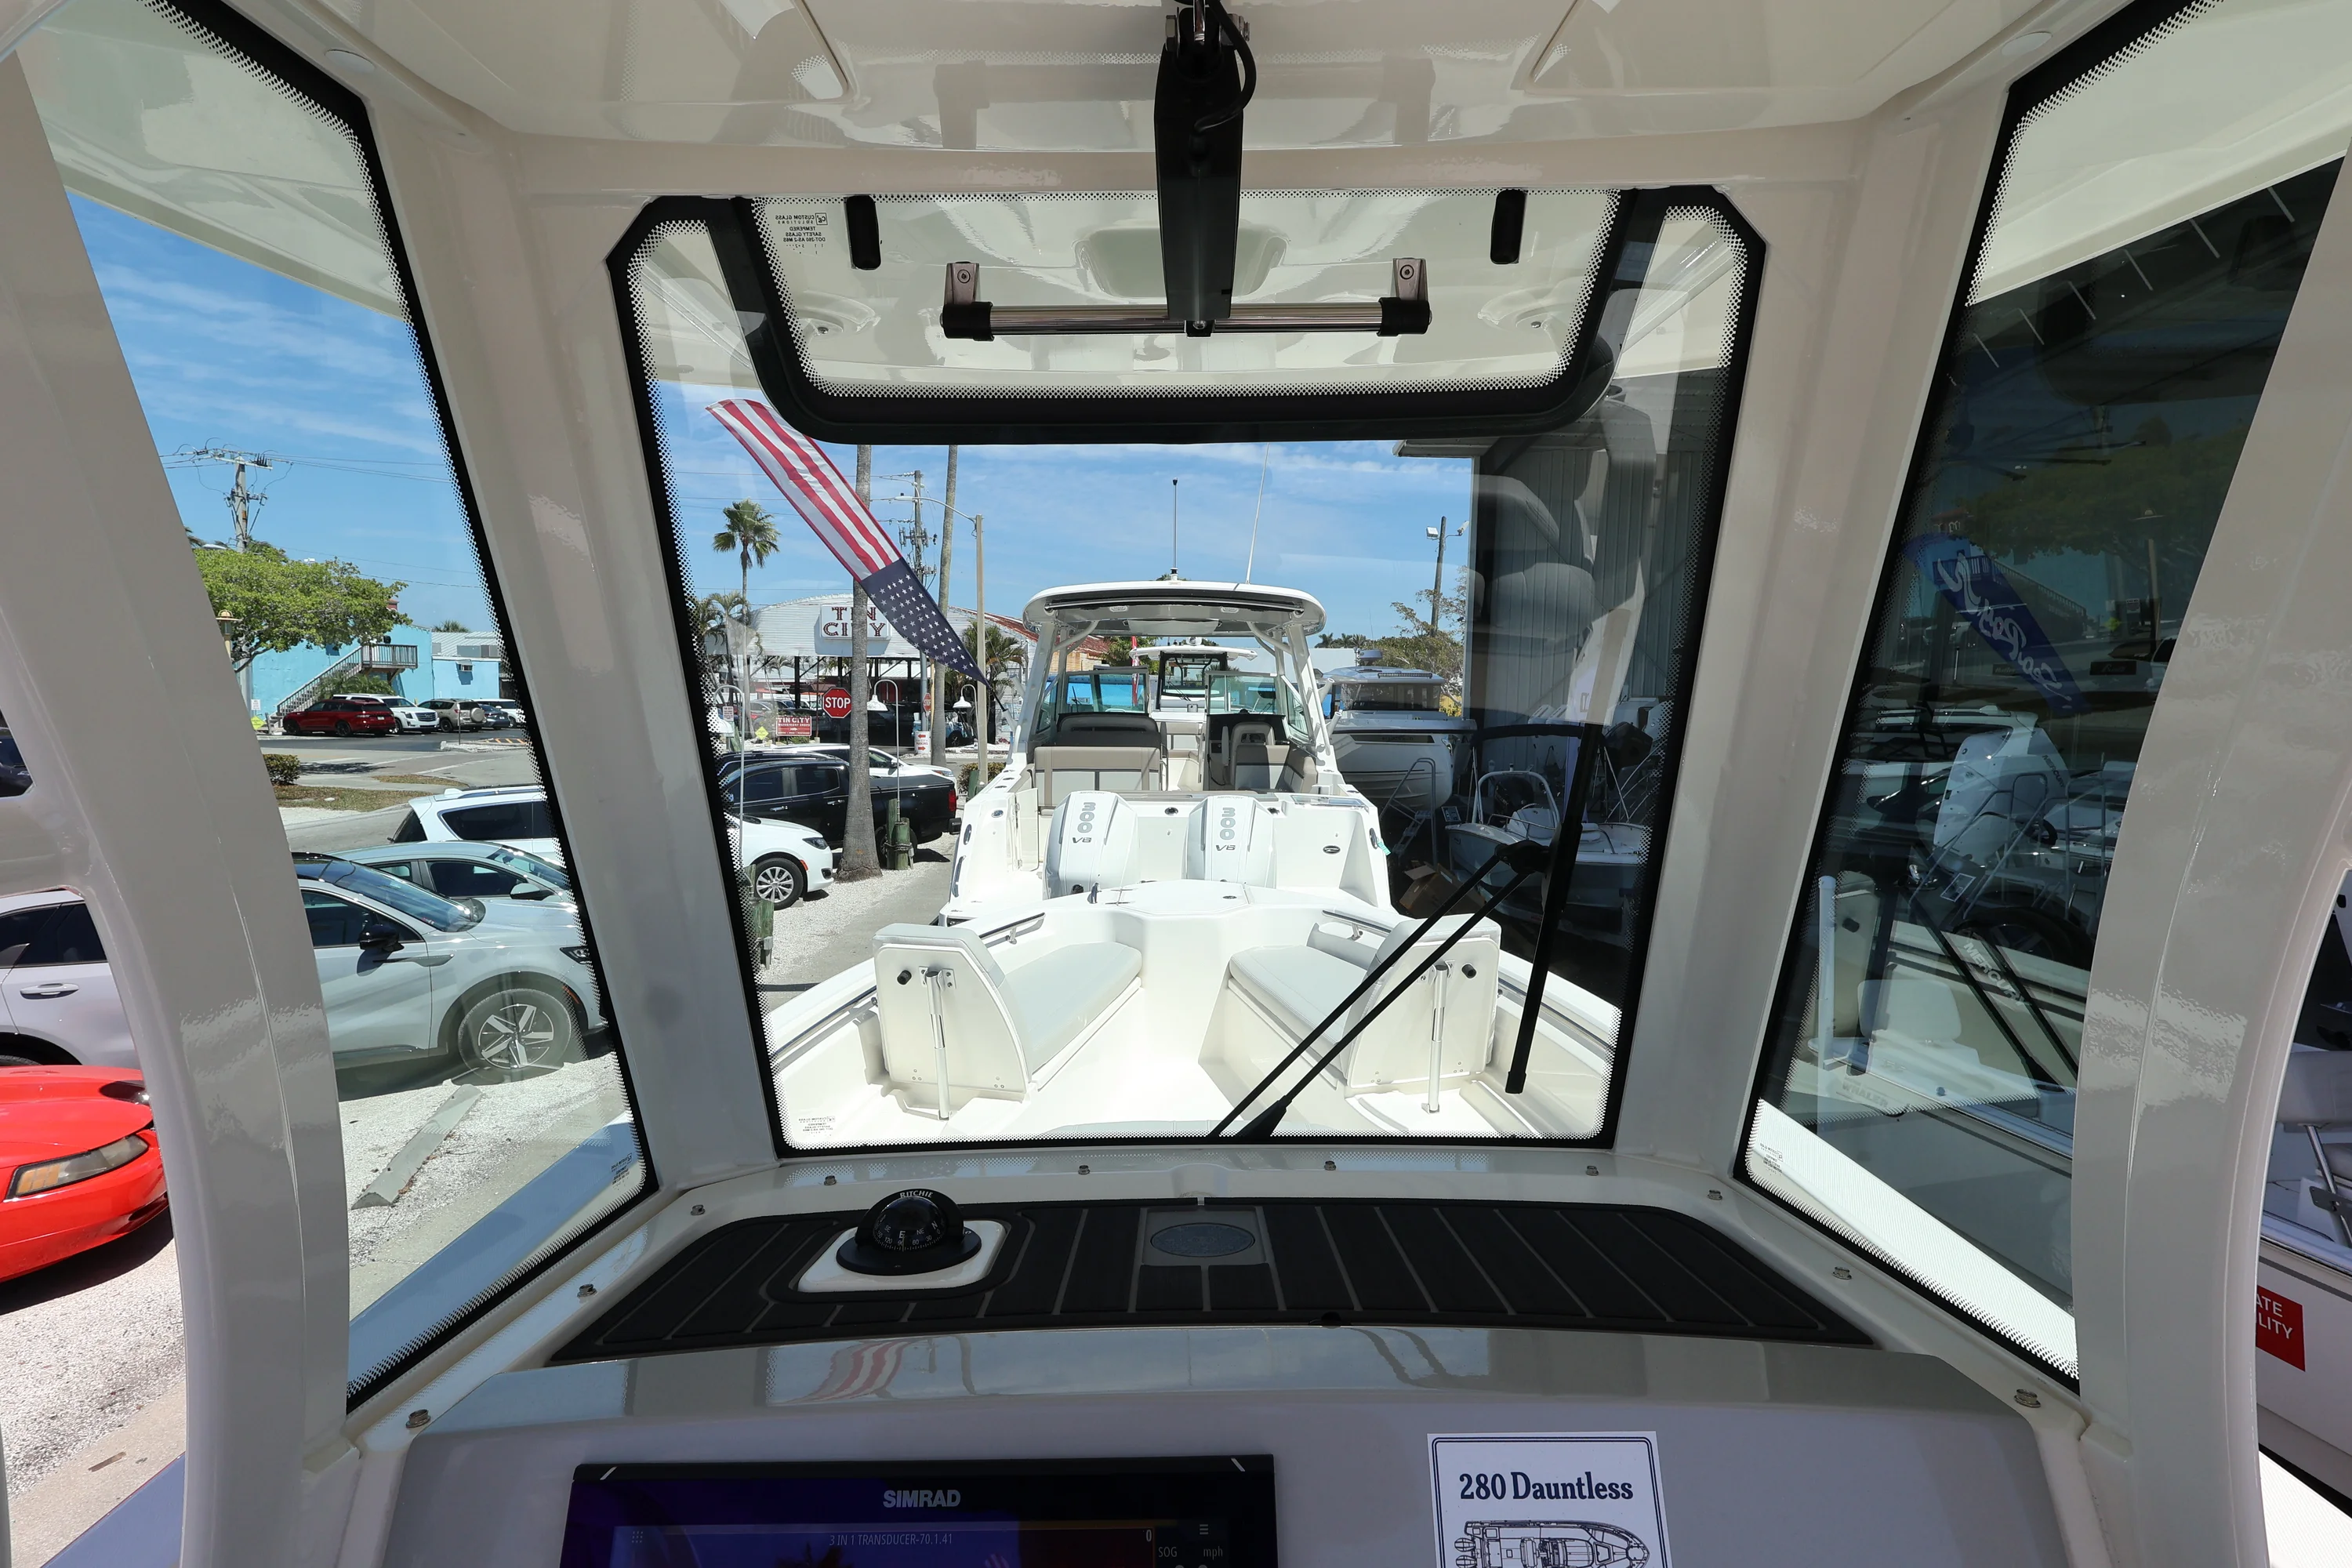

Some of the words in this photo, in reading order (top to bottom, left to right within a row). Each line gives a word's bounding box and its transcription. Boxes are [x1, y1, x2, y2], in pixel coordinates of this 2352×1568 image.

[823, 622, 885, 637] CIY
[825, 696, 851, 709] STOP
[1077, 802, 1096, 833] 300
[1220, 808, 1236, 840] 300
[1964, 942, 2032, 1006] MERCURY
[899, 1190, 933, 1199] RITCHIE
[931, 1221, 938, 1229] N
[1459, 1473, 1507, 1500] 280
[1510, 1471, 1633, 1500] Dauntless
[883, 1490, 961, 1508] SIMRAD
[829, 1534, 835, 1545] 3
[837, 1534, 847, 1545] IN
[858, 1533, 953, 1545] TRANSDUCER-70.1.41
[1145, 1529, 1152, 1542] 0
[1158, 1546, 1178, 1558] SOG
[1203, 1545, 1223, 1560] mph
